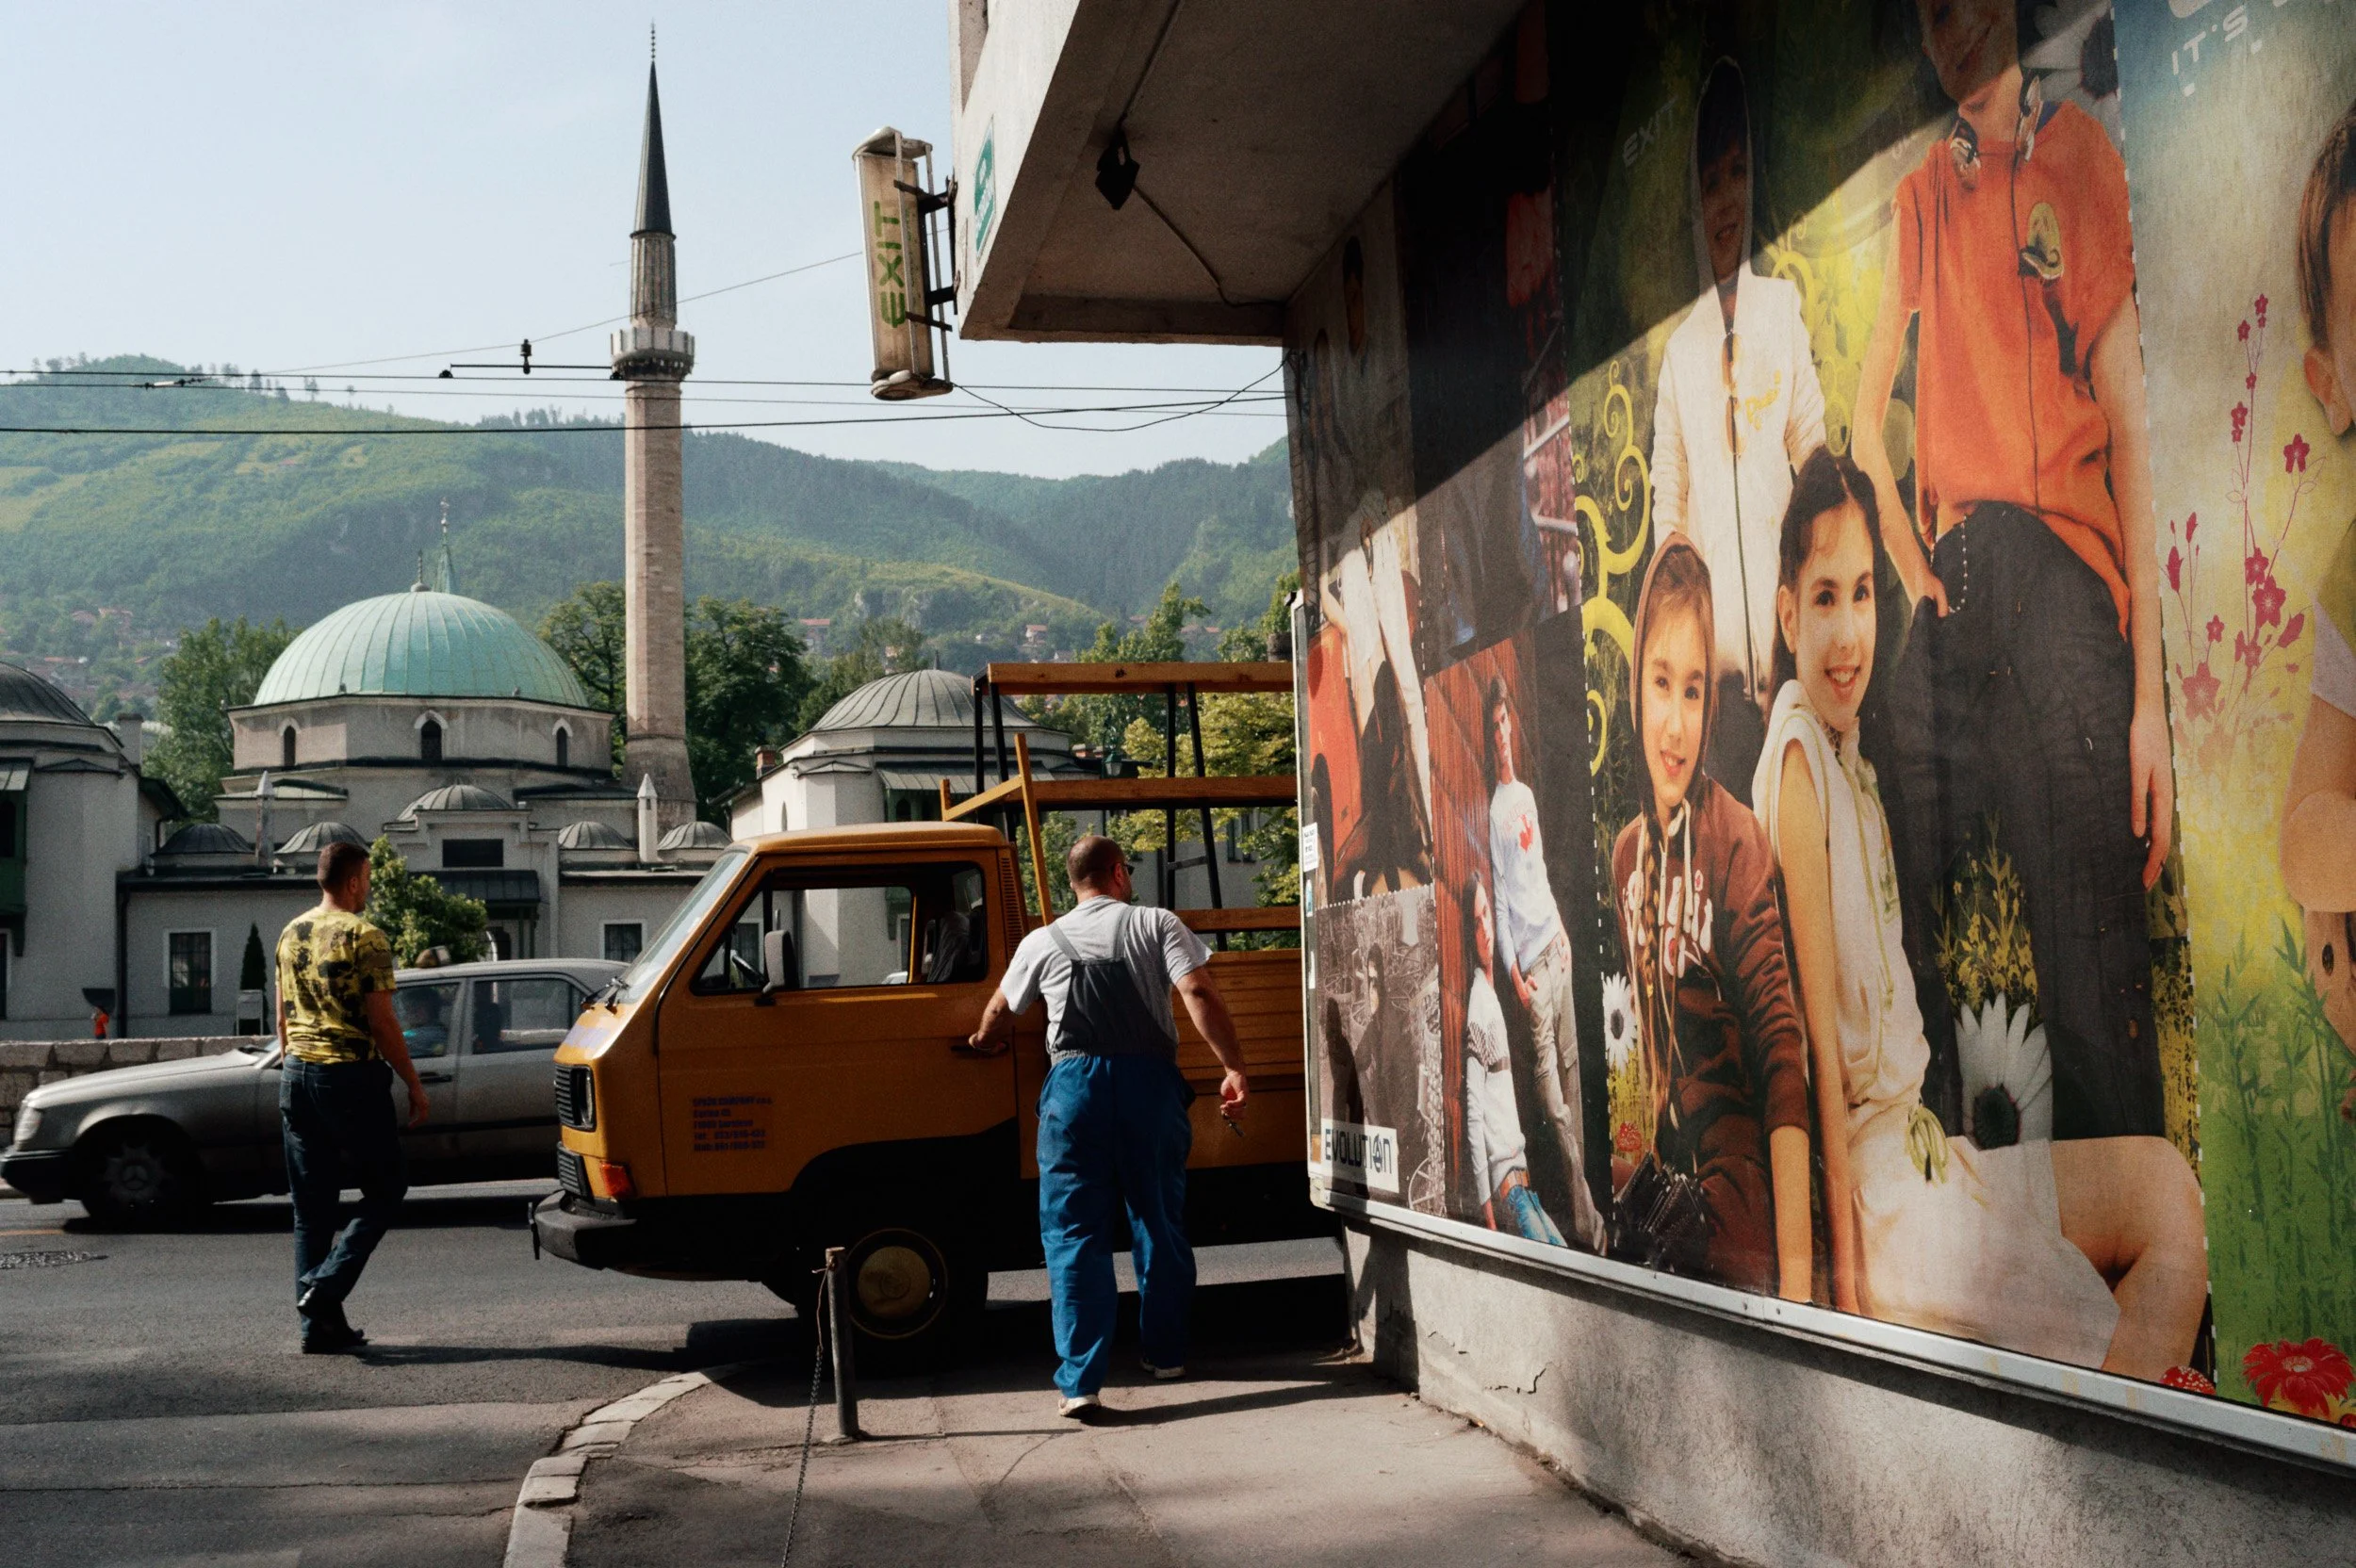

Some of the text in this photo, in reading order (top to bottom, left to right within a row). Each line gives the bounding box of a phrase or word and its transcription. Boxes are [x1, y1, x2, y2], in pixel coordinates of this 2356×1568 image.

[2170, 5, 2249, 76] IT'S
[1622, 93, 1679, 168] EXIT
[873, 200, 908, 329] EXIT
